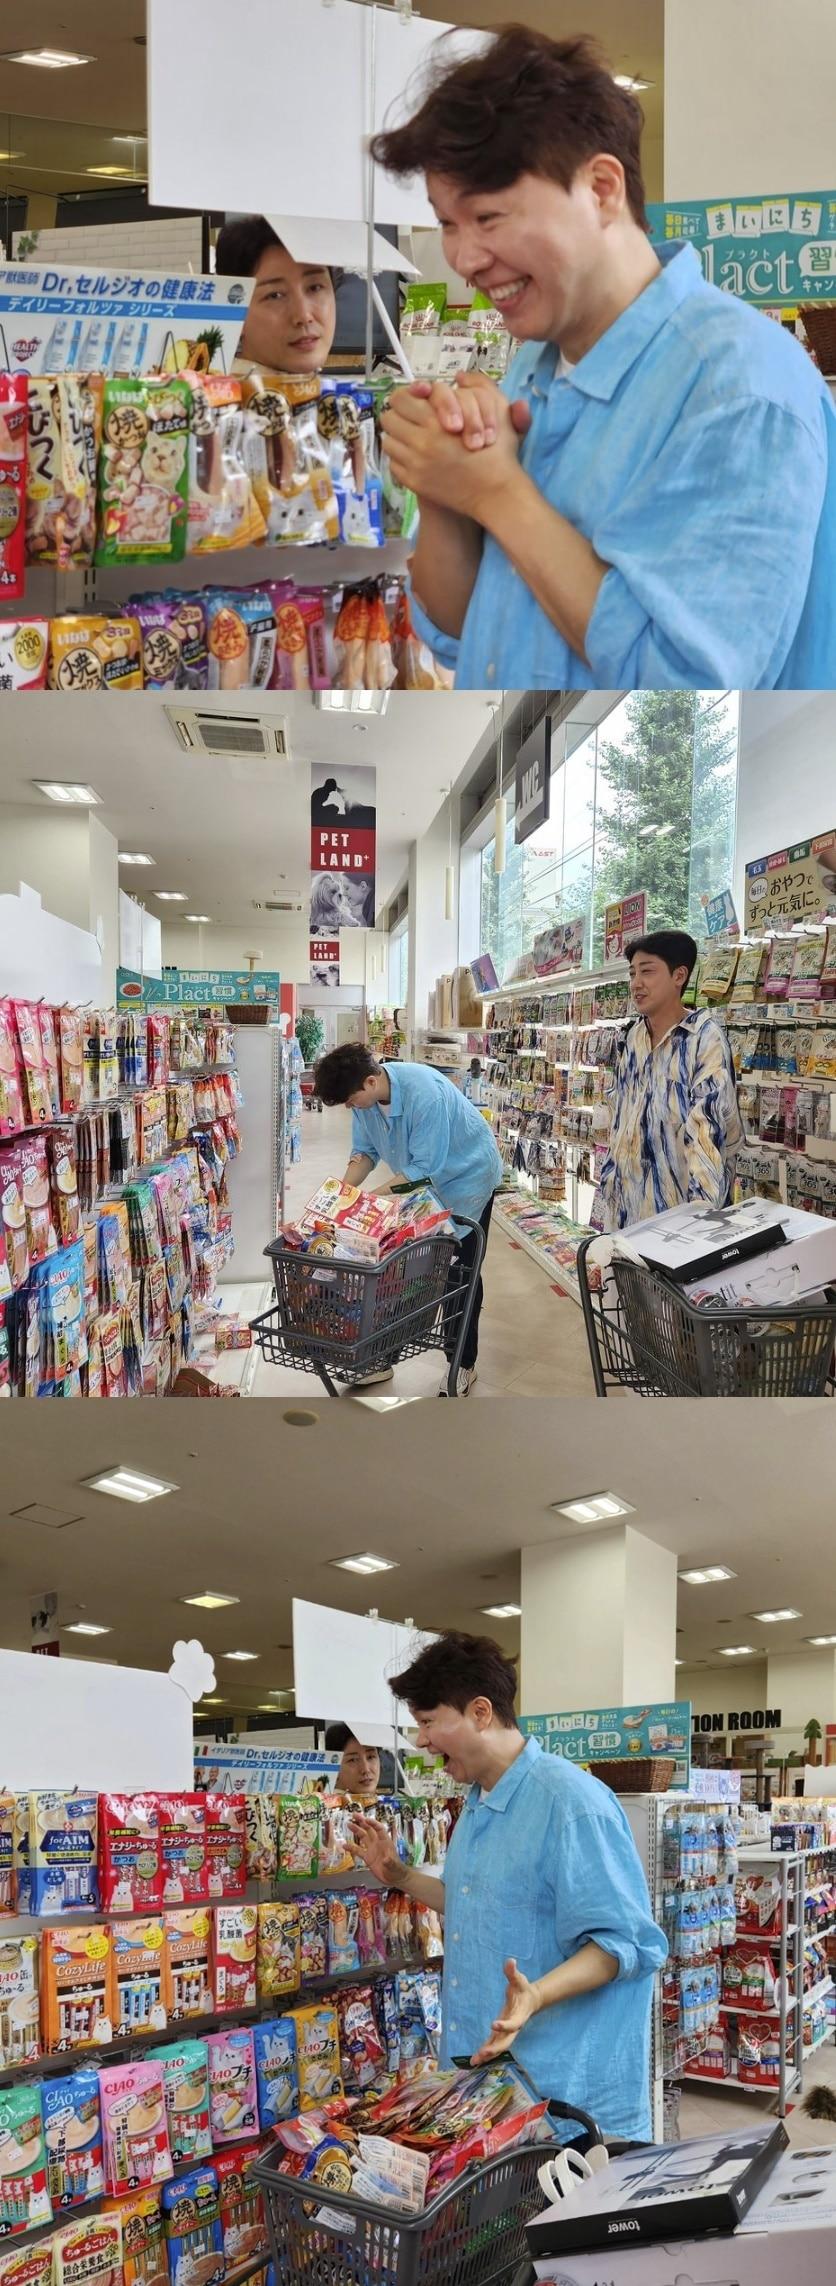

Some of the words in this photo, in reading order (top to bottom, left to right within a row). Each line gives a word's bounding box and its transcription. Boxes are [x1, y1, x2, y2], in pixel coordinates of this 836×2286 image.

[714, 208, 813, 232] まいにち
[809, 246, 836, 271] 習
[702, 243, 795, 296] lact
[802, 279, 836, 293] キャン
[16, 634, 40, 655] 2000
[62, 652, 98, 685] 焼
[320, 832, 350, 847] PET
[770, 872, 814, 896] おやつで
[749, 890, 820, 922] ずっと元気に。
[313, 943, 328, 951] PET
[163, 983, 210, 1001] Plact
[549, 1717, 595, 1729] まいにち
[728, 1709, 782, 1731] ROOM
[592, 1733, 617, 1746] 習慣
[219, 1919, 242, 1928] すごい
[219, 1929, 242, 1939] 乳酸菌
[170, 1940, 208, 1953] CozyLife
[56, 1961, 106, 1977] CozyLife
[163, 2059, 184, 2070] IAO
[104, 2079, 134, 2096] CIAO
[608, 2220, 641, 2234] tower
